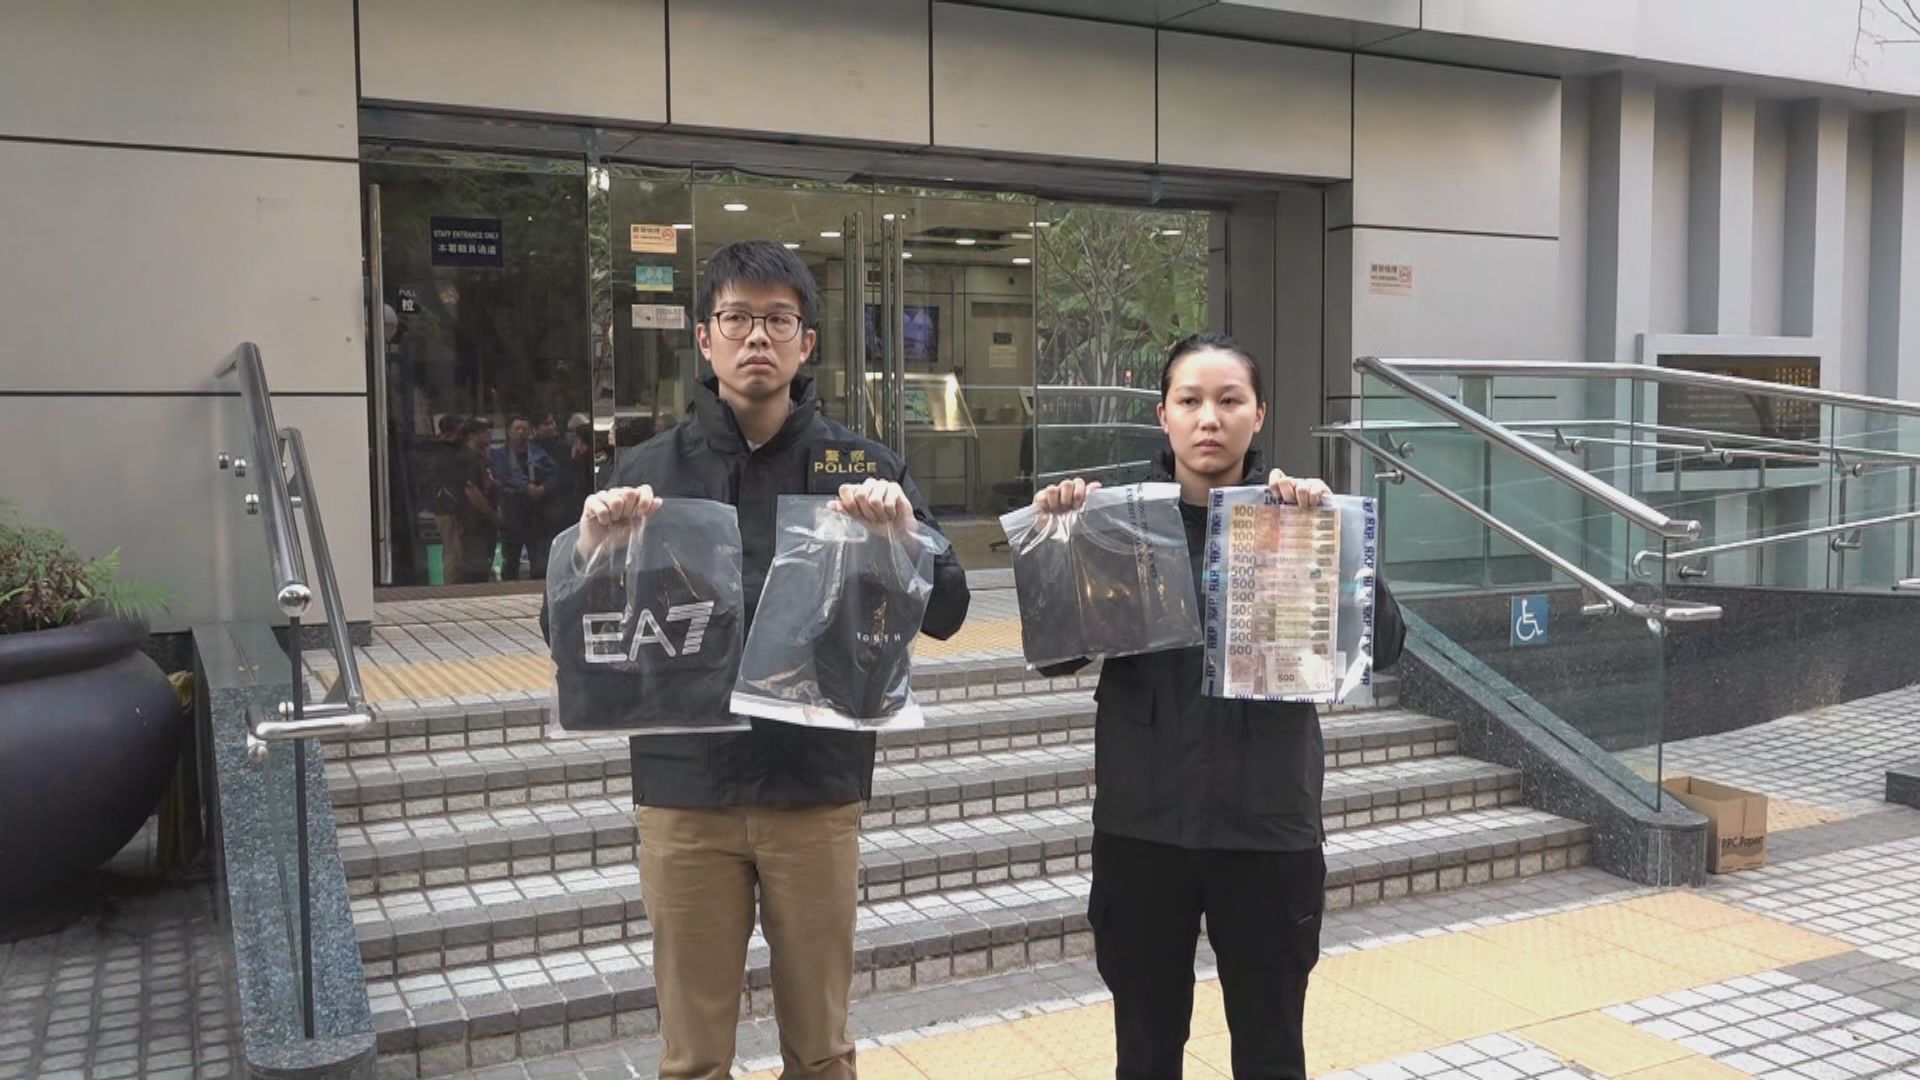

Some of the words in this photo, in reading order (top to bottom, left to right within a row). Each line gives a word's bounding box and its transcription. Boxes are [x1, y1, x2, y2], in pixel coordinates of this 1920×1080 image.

[401, 298, 415, 311] 拉
[814, 462, 877, 473] POLICE
[1231, 566, 1255, 577] 500
[1231, 578, 1255, 589] 500
[1231, 591, 1255, 602] 500
[1231, 604, 1254, 615] 500
[1230, 617, 1253, 629] 500
[583, 601, 714, 663] EA7
[1230, 632, 1253, 643] 500
[1229, 644, 1252, 655] 500
[1277, 674, 1295, 683] 500
